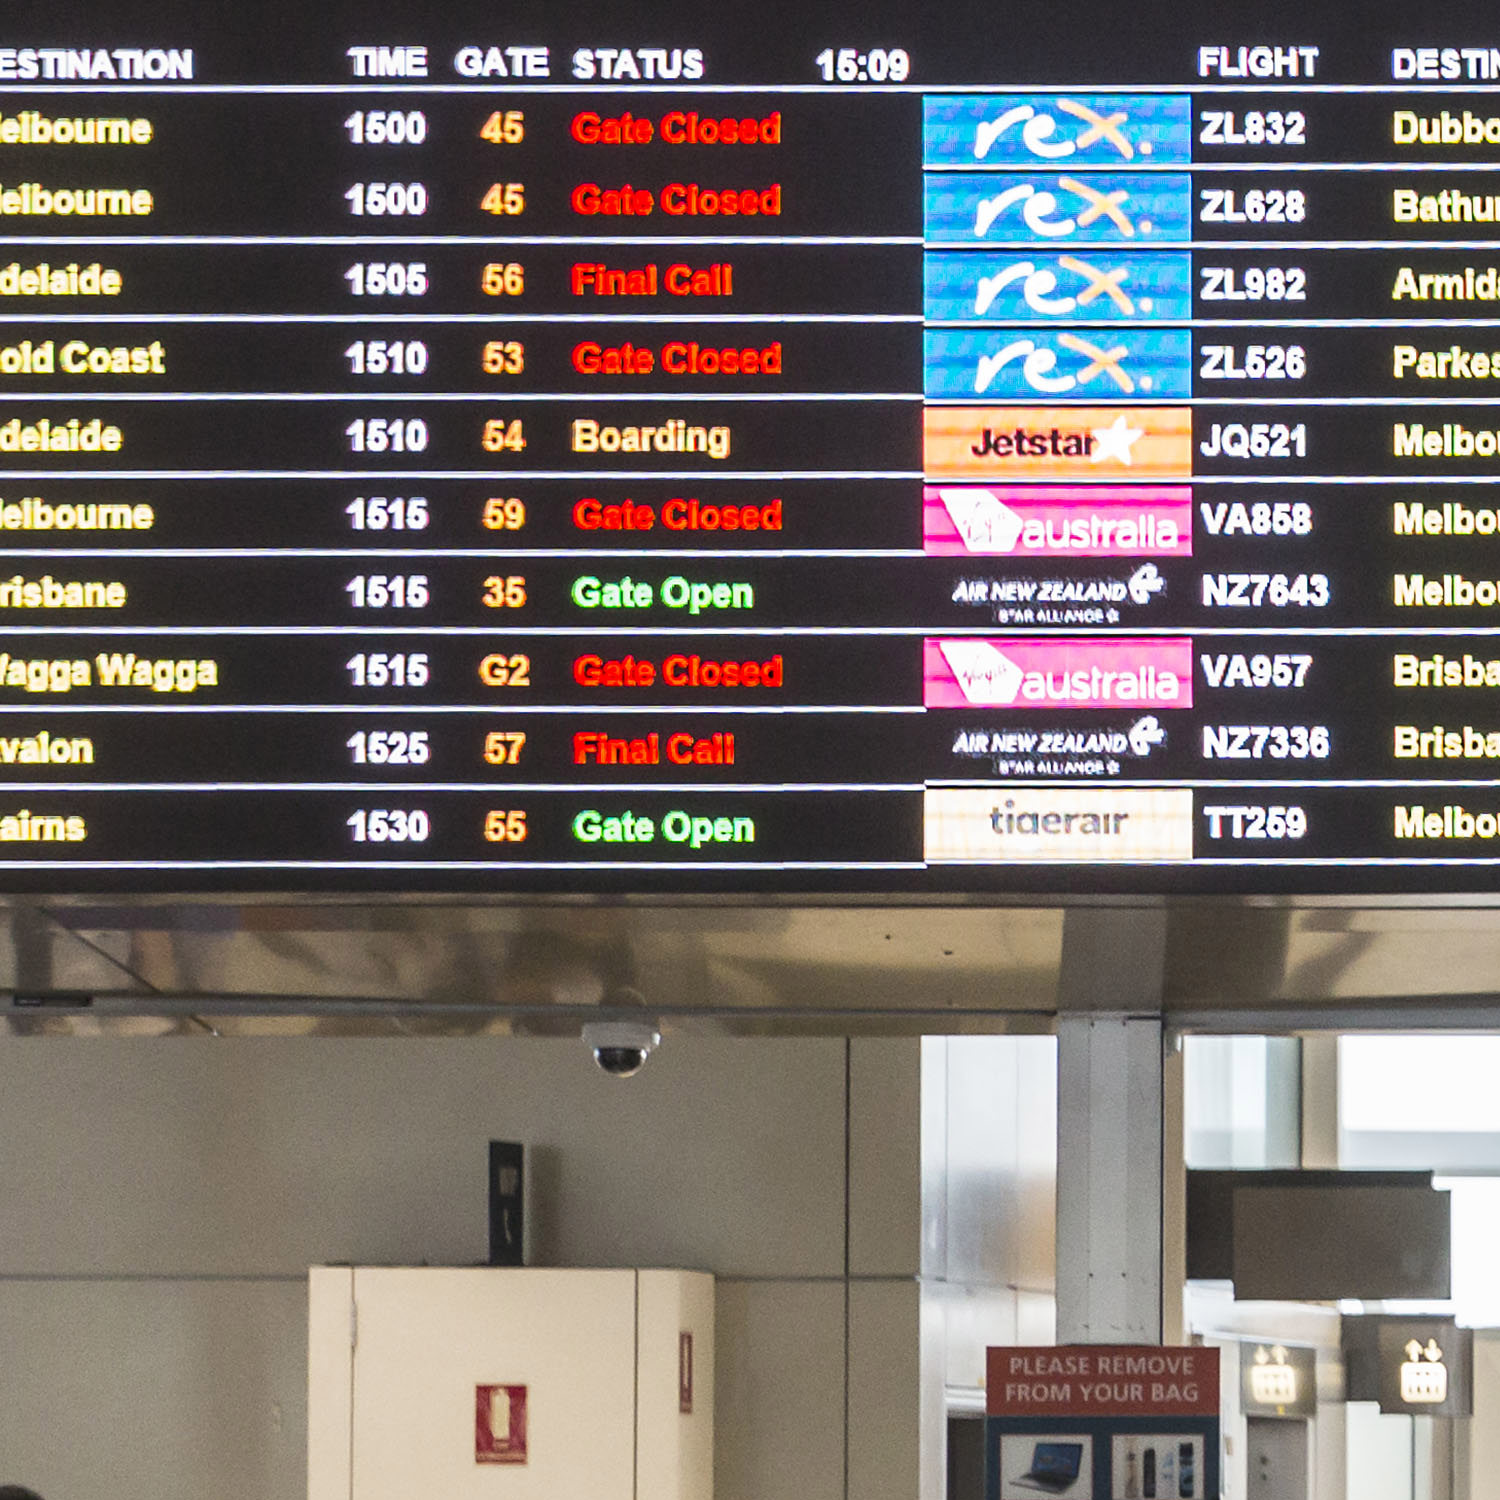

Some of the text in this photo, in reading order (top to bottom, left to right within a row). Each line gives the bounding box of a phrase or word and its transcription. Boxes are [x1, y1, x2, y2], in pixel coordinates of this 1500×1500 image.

[1198, 46, 1319, 77] FLIGHT
[344, 110, 781, 144] 1500 45 Gate Closed
[1200, 111, 1305, 145] ZL832
[1200, 189, 1305, 223] ZL628
[344, 263, 732, 296] 1505 56 Final Call
[1200, 267, 1306, 300] ZL982
[1200, 345, 1306, 379] ZL526
[346, 419, 730, 459] 1510 54 Boarding
[972, 429, 1096, 456] Jetstar
[1200, 424, 1305, 458] JQ521
[1200, 503, 1312, 535] VA858
[346, 575, 753, 614] 1515 35 Gate Open
[1202, 574, 1330, 606] NZ7643
[1200, 654, 1313, 687] VA957
[1203, 726, 1331, 759] NZ7336
[1203, 806, 1307, 838] TT259
[1010, 1356, 1193, 1375] PLEASE REMOVE
[1006, 1383, 1197, 1401] FROM YOUR BAG
